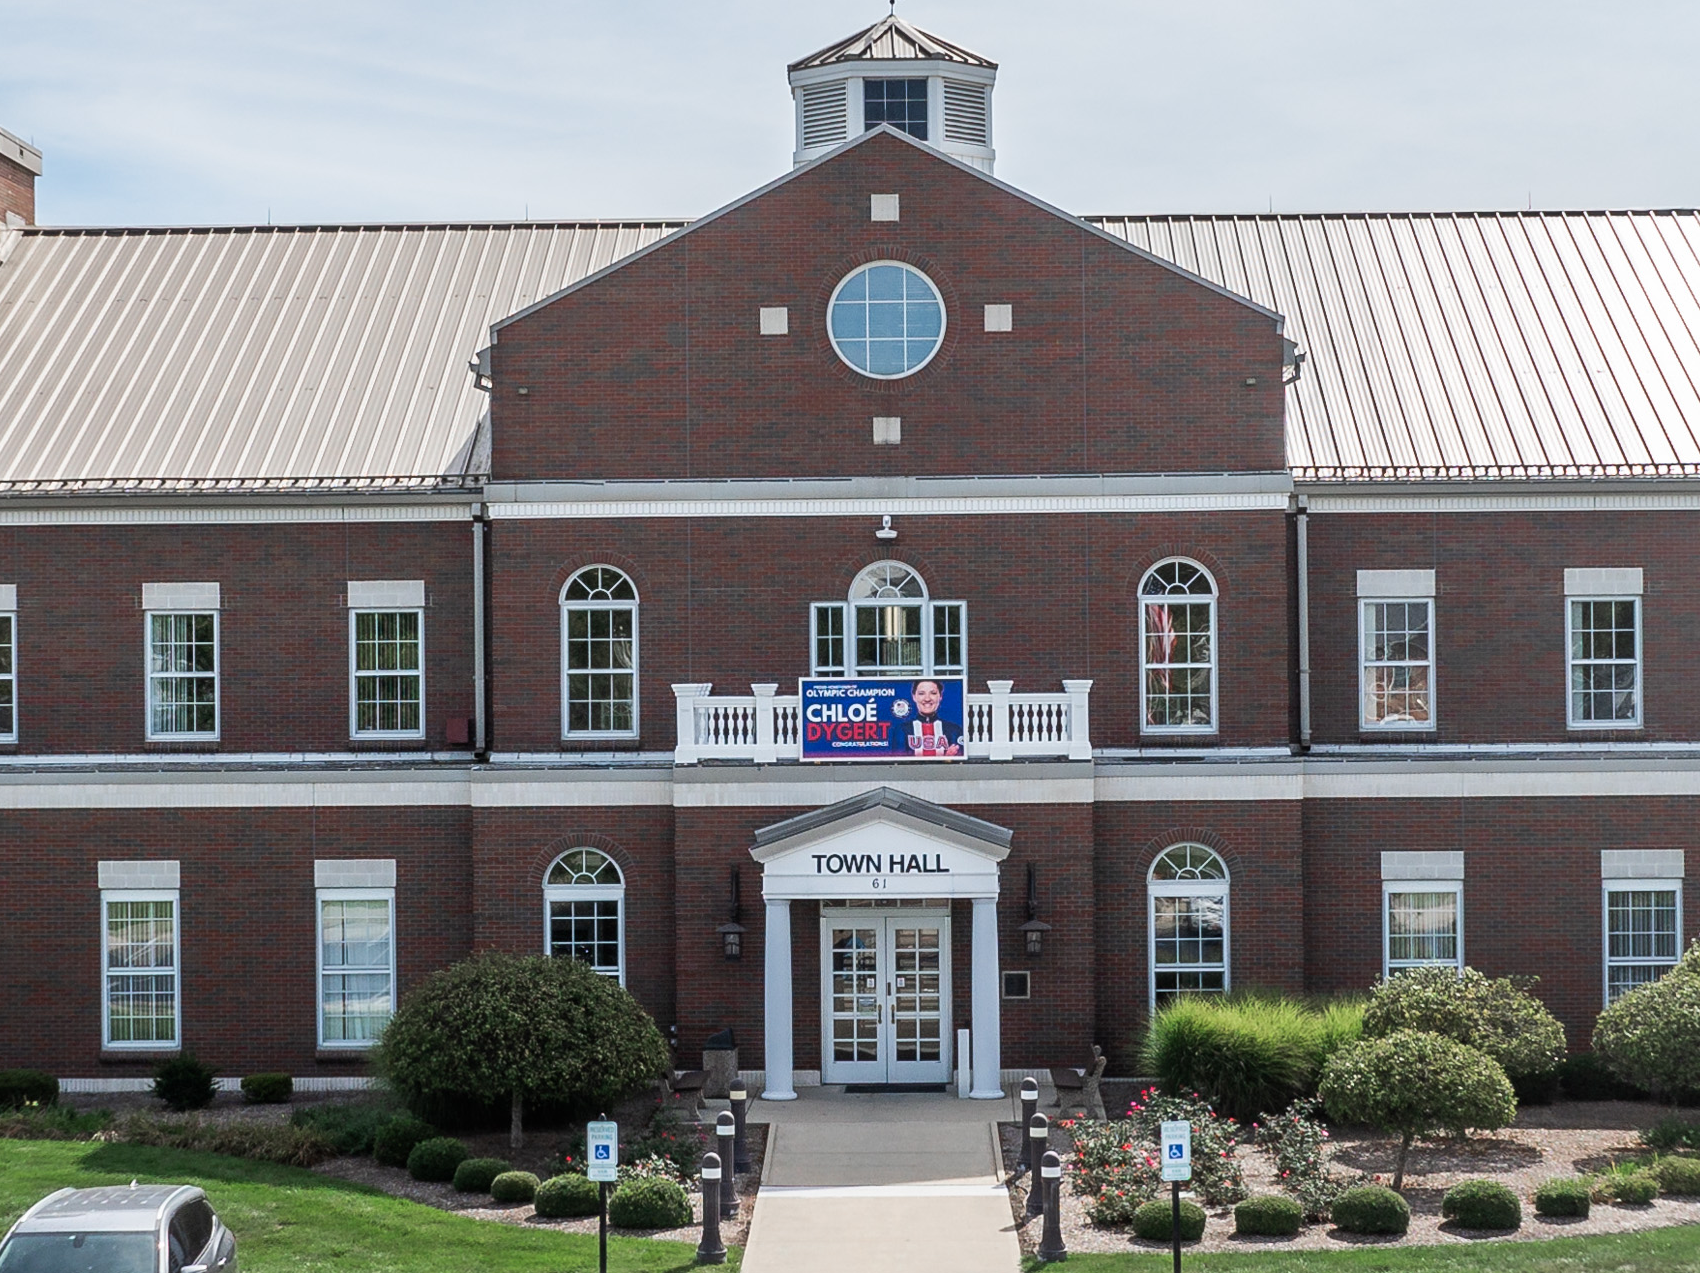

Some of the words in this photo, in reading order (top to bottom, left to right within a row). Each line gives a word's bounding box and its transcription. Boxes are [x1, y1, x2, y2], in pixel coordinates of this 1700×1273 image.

[806, 689, 846, 698] OLYMPIC
[847, 688, 896, 697] CHAMPION
[806, 697, 877, 723] CHLOÉ
[807, 722, 891, 741] DYGERT
[908, 734, 949, 750] USA
[811, 853, 882, 874] TOWN
[889, 853, 950, 873] HALL
